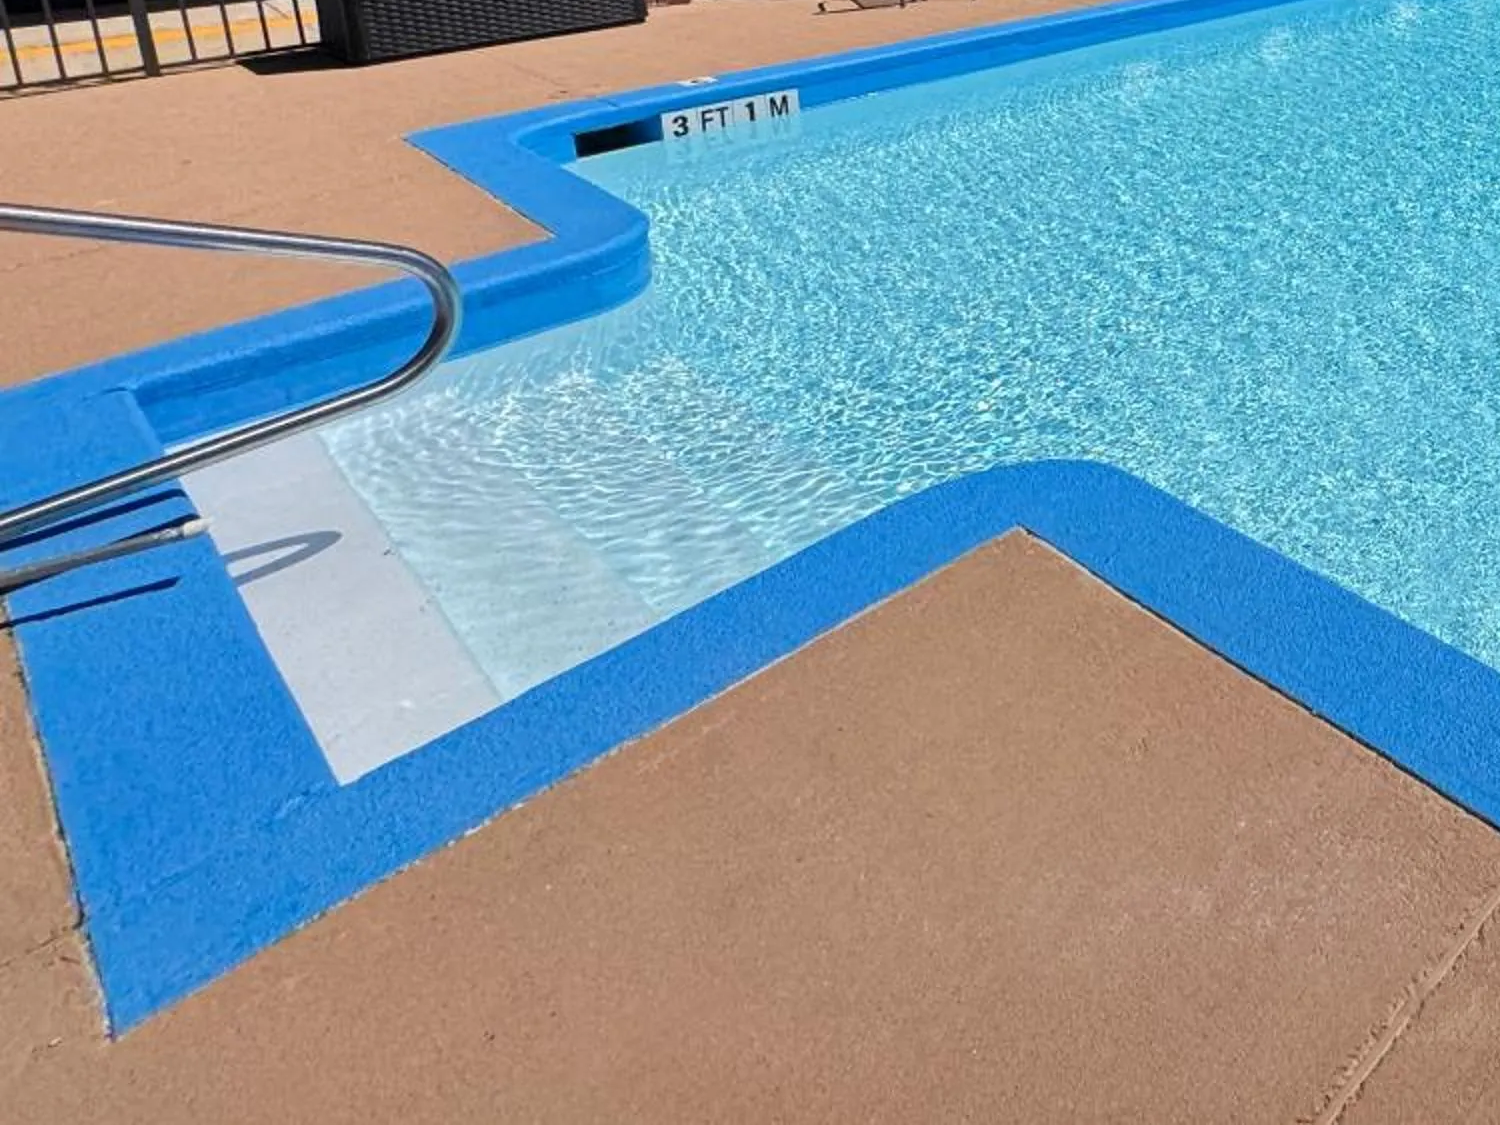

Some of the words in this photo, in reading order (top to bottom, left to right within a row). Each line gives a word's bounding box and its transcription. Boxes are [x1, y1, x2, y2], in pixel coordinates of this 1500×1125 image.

[671, 115, 689, 137] 3
[701, 106, 729, 132] FT
[744, 101, 756, 122] 1
[769, 94, 789, 118] M
